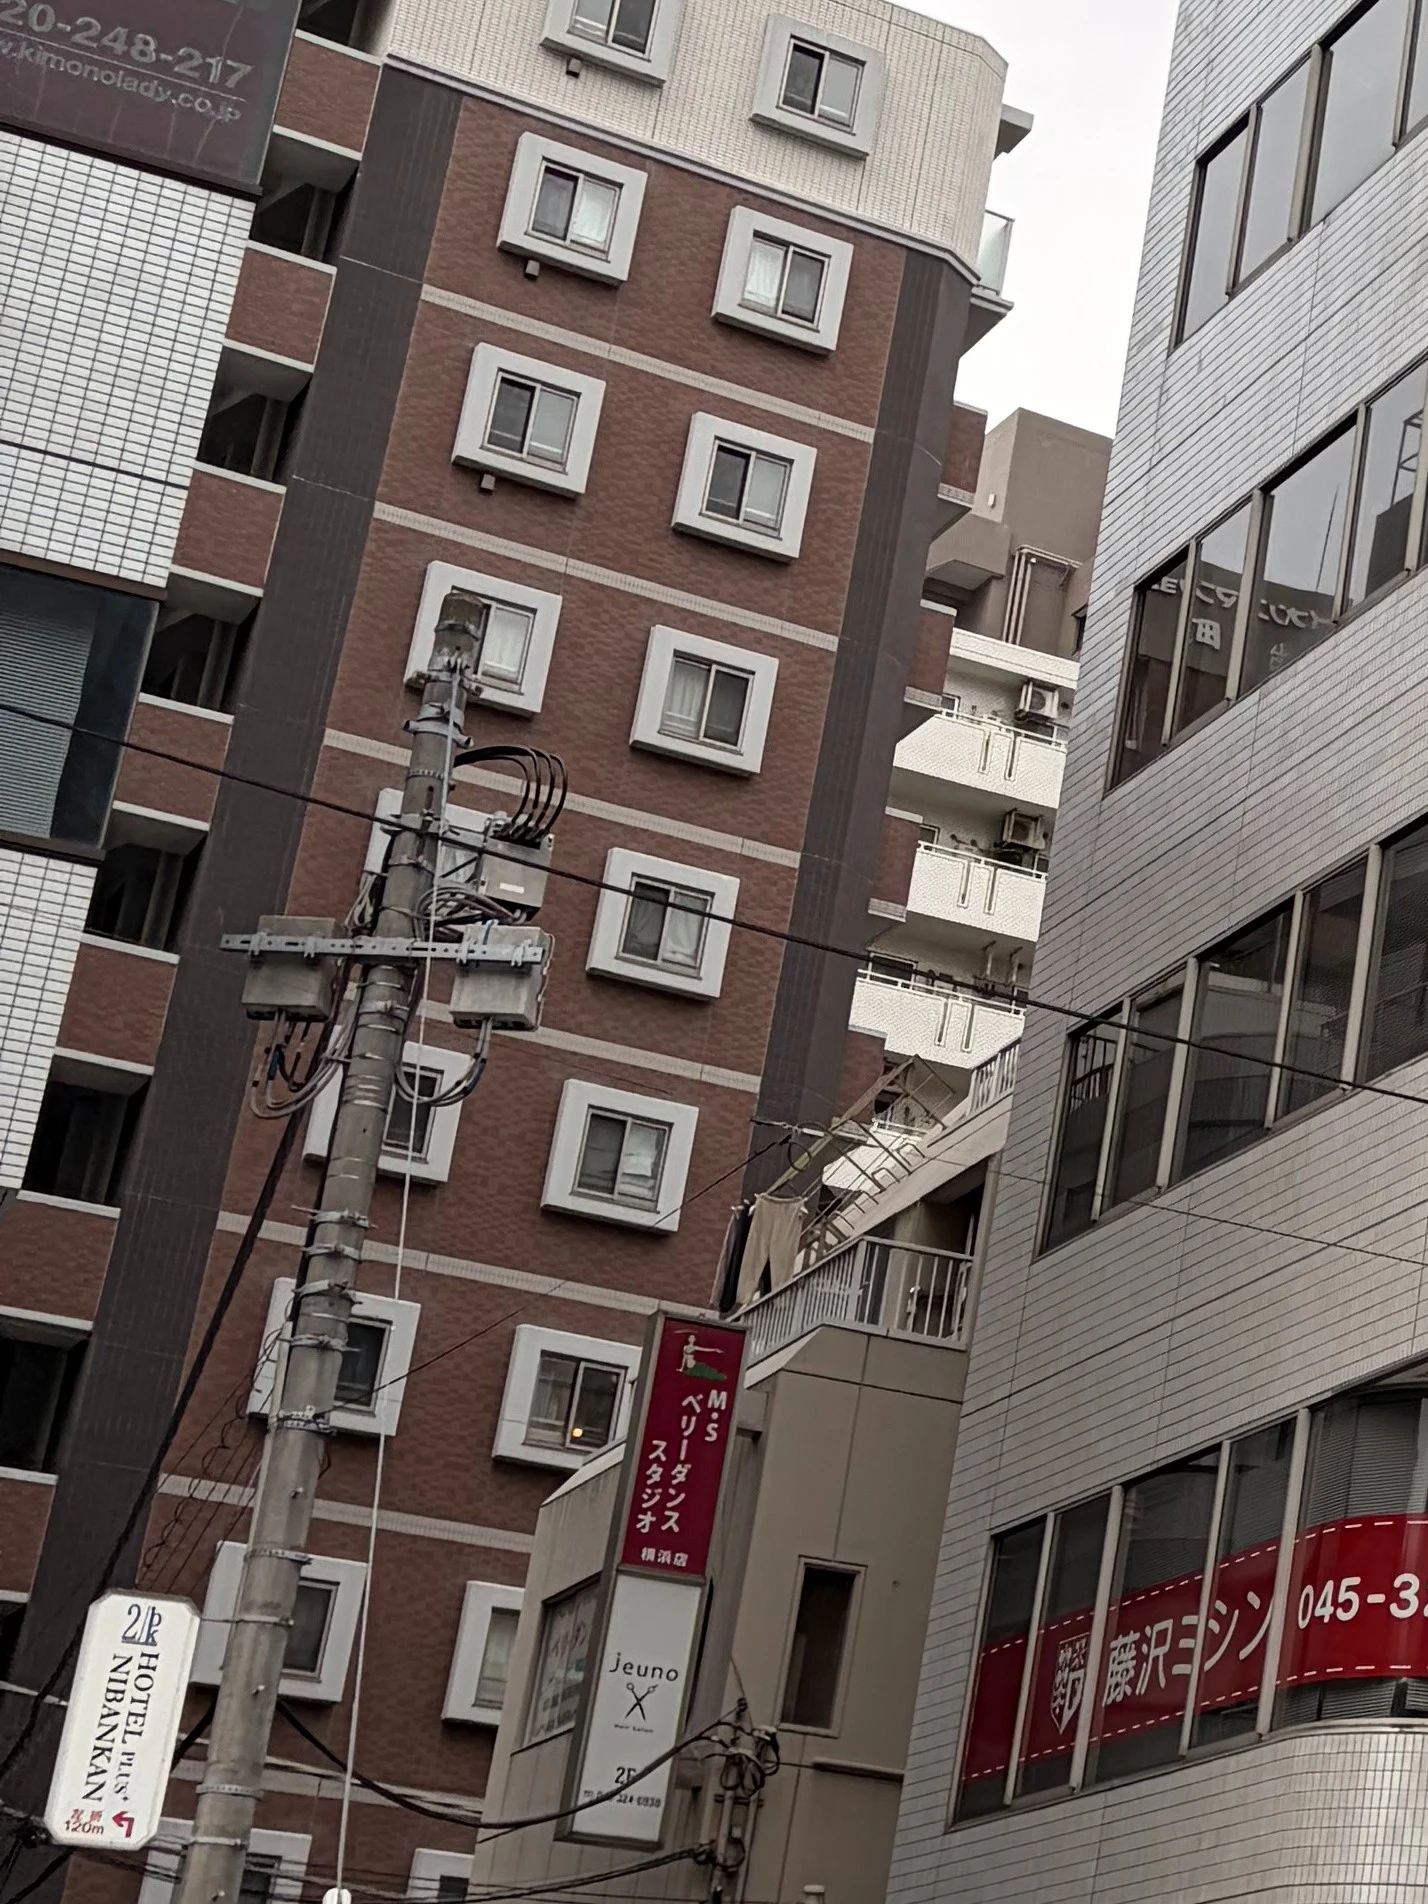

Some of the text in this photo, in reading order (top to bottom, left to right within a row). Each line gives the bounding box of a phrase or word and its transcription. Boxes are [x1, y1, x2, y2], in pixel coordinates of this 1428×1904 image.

[635, 1439, 668, 1534] スタジオ
[660, 1393, 704, 1534] ベリーダンス
[608, 1651, 679, 1682] jeuno
[1101, 1590, 1273, 1708] 藤沢ミシン
[81, 1653, 134, 1802] NIBANKAN
[121, 1651, 161, 1745] HOTEL
[65, 1819, 105, 1836] 120m
